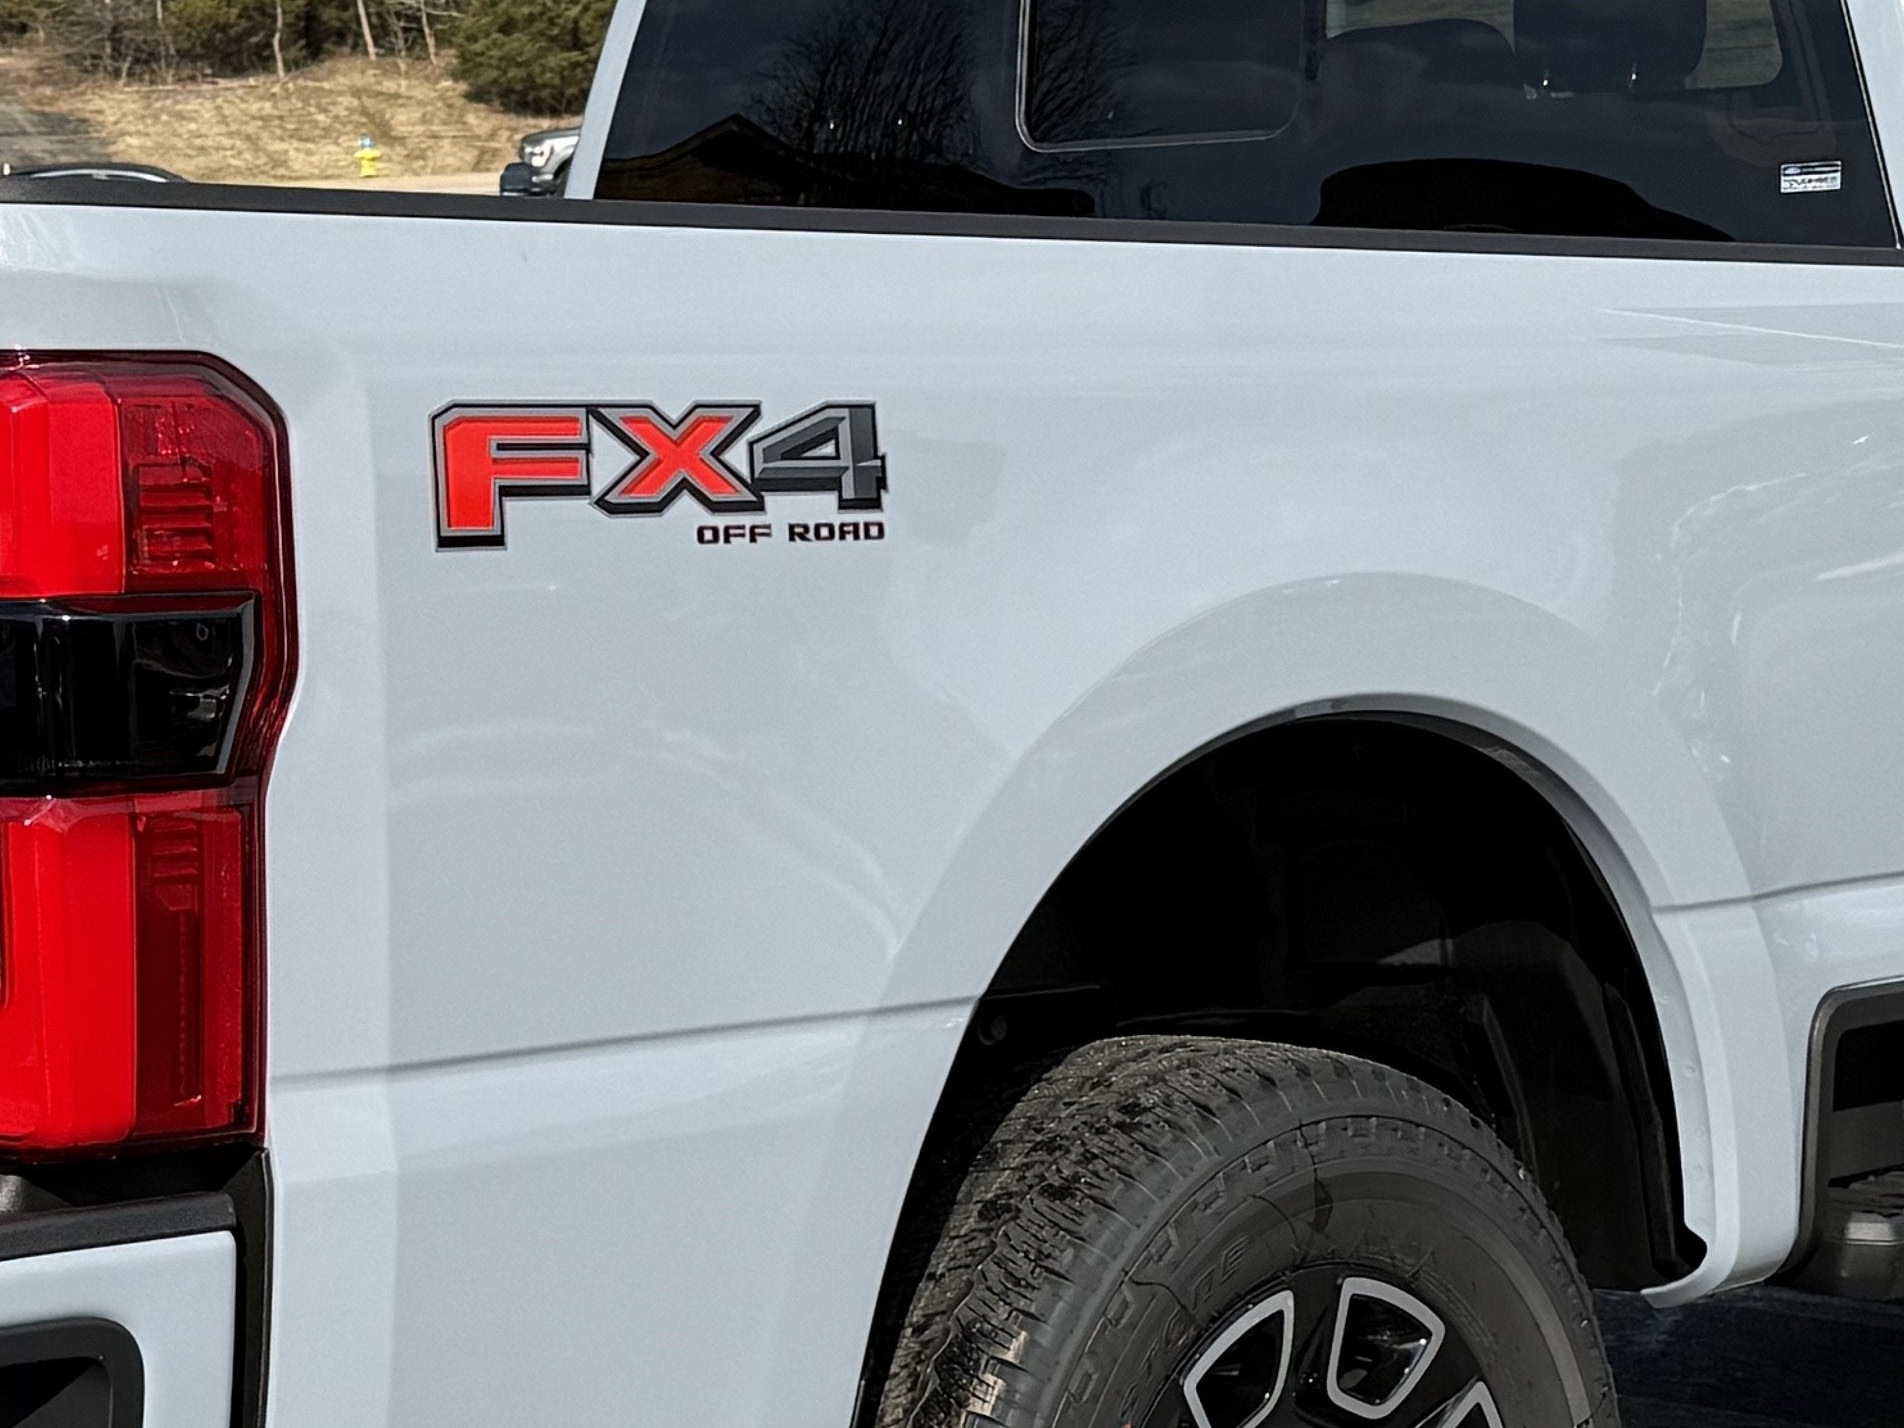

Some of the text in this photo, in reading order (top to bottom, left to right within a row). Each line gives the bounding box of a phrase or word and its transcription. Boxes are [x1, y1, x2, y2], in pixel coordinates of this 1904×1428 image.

[428, 399, 888, 552] FX4
[696, 521, 886, 545] OFF ROAD
